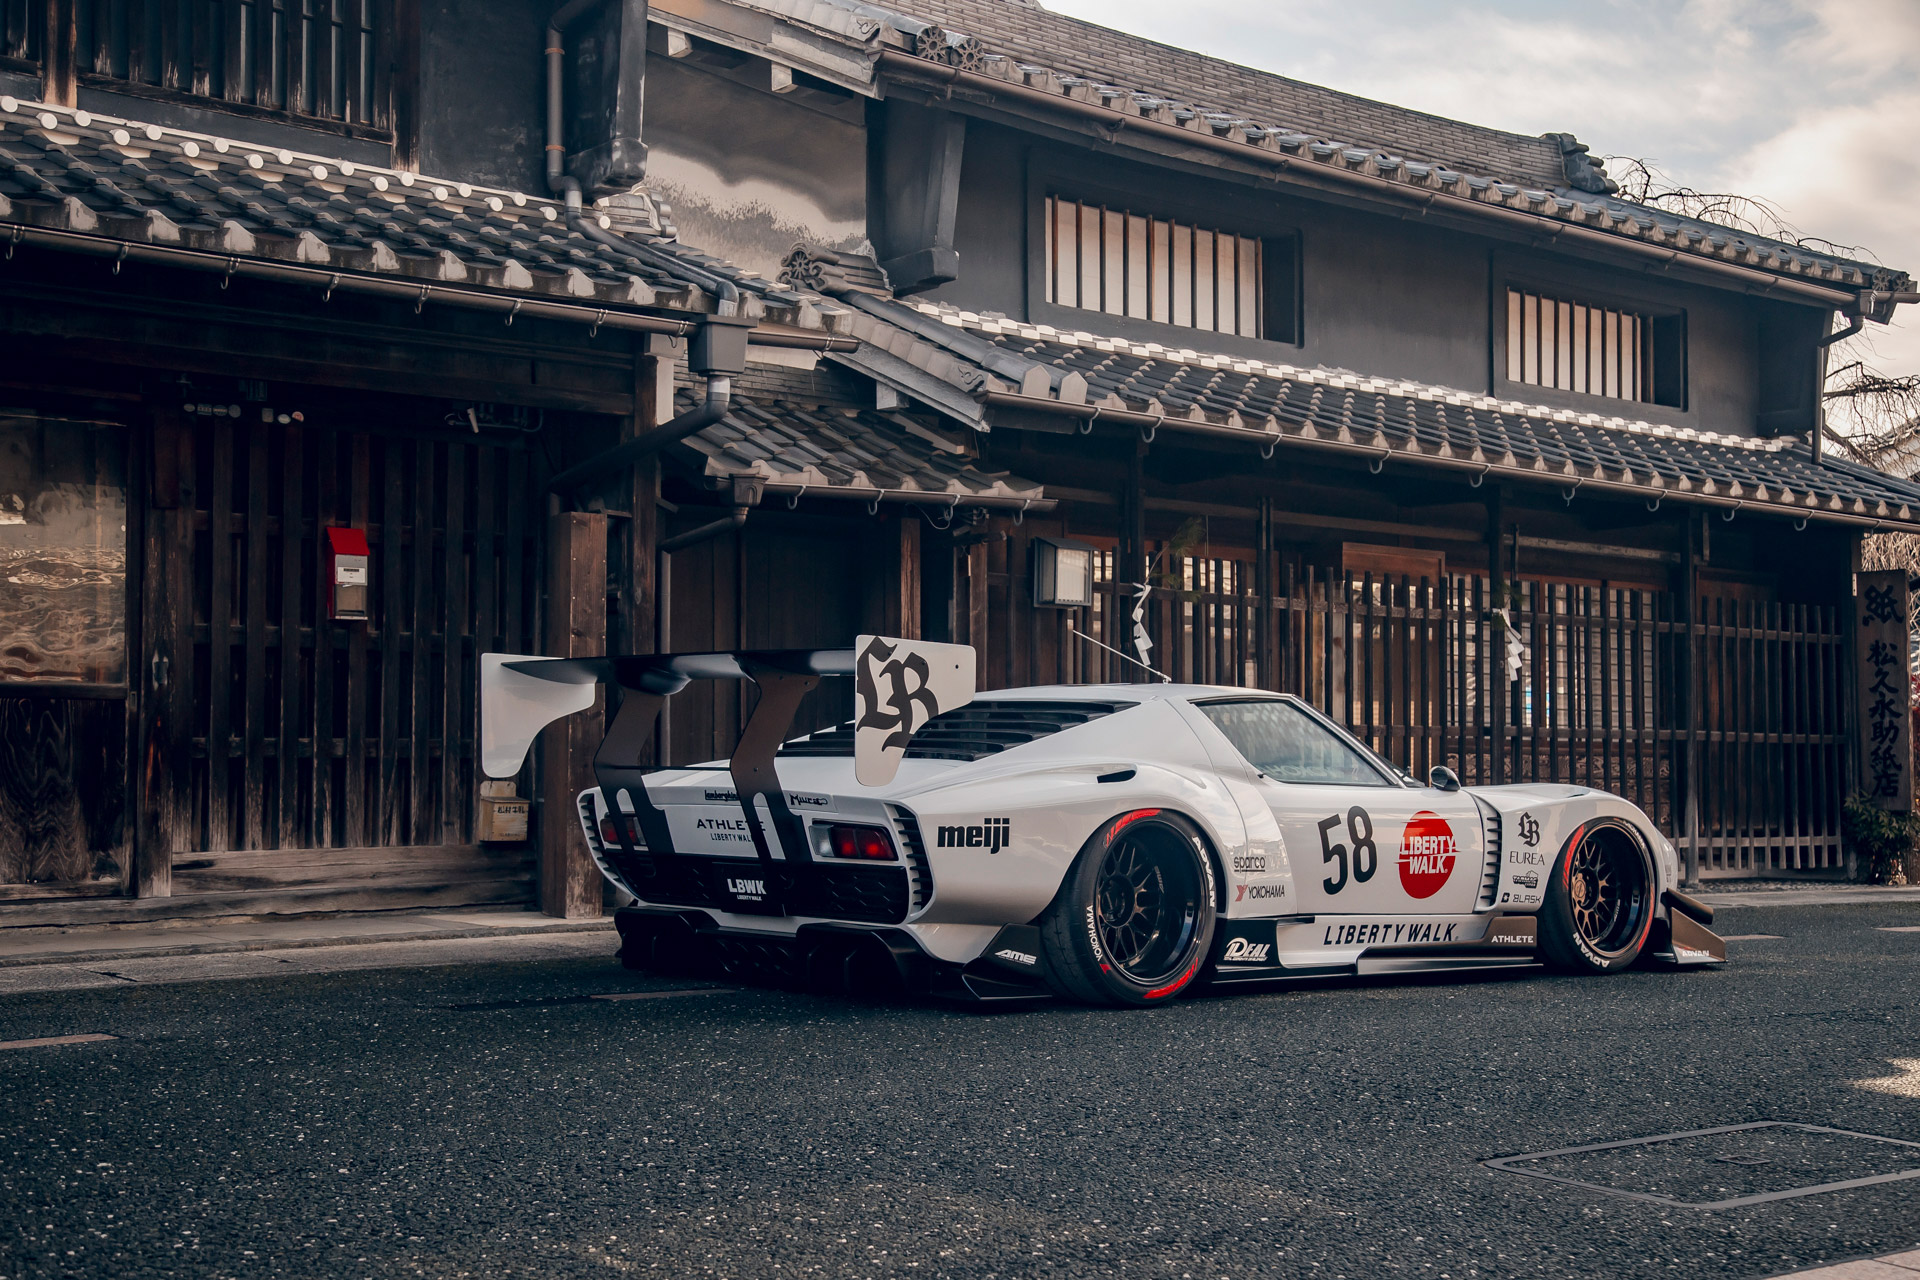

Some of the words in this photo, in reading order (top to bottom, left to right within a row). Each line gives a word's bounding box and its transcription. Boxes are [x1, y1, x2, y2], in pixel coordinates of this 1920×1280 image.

[1862, 584, 1904, 626] 紙
[697, 818, 766, 832] ATHLEE
[710, 833, 736, 842] LIBERTY
[736, 834, 754, 843] WAL
[937, 818, 1010, 854] meiji
[1317, 805, 1378, 895] 58
[1401, 836, 1456, 855] LIBERTY
[1233, 856, 1266, 873] sparco
[1409, 856, 1447, 875] WALK
[1509, 850, 1546, 866] EUREA
[727, 878, 767, 895] LBWK
[1248, 885, 1286, 899] YOKOHAMA
[1086, 904, 1102, 962] YOKOHAMA
[1323, 923, 1406, 946] LIBERTY
[1407, 922, 1457, 943] WALK
[1491, 935, 1534, 943] ATHLETE
[994, 949, 1037, 965] AME
[1573, 931, 1610, 968] ADVAN
